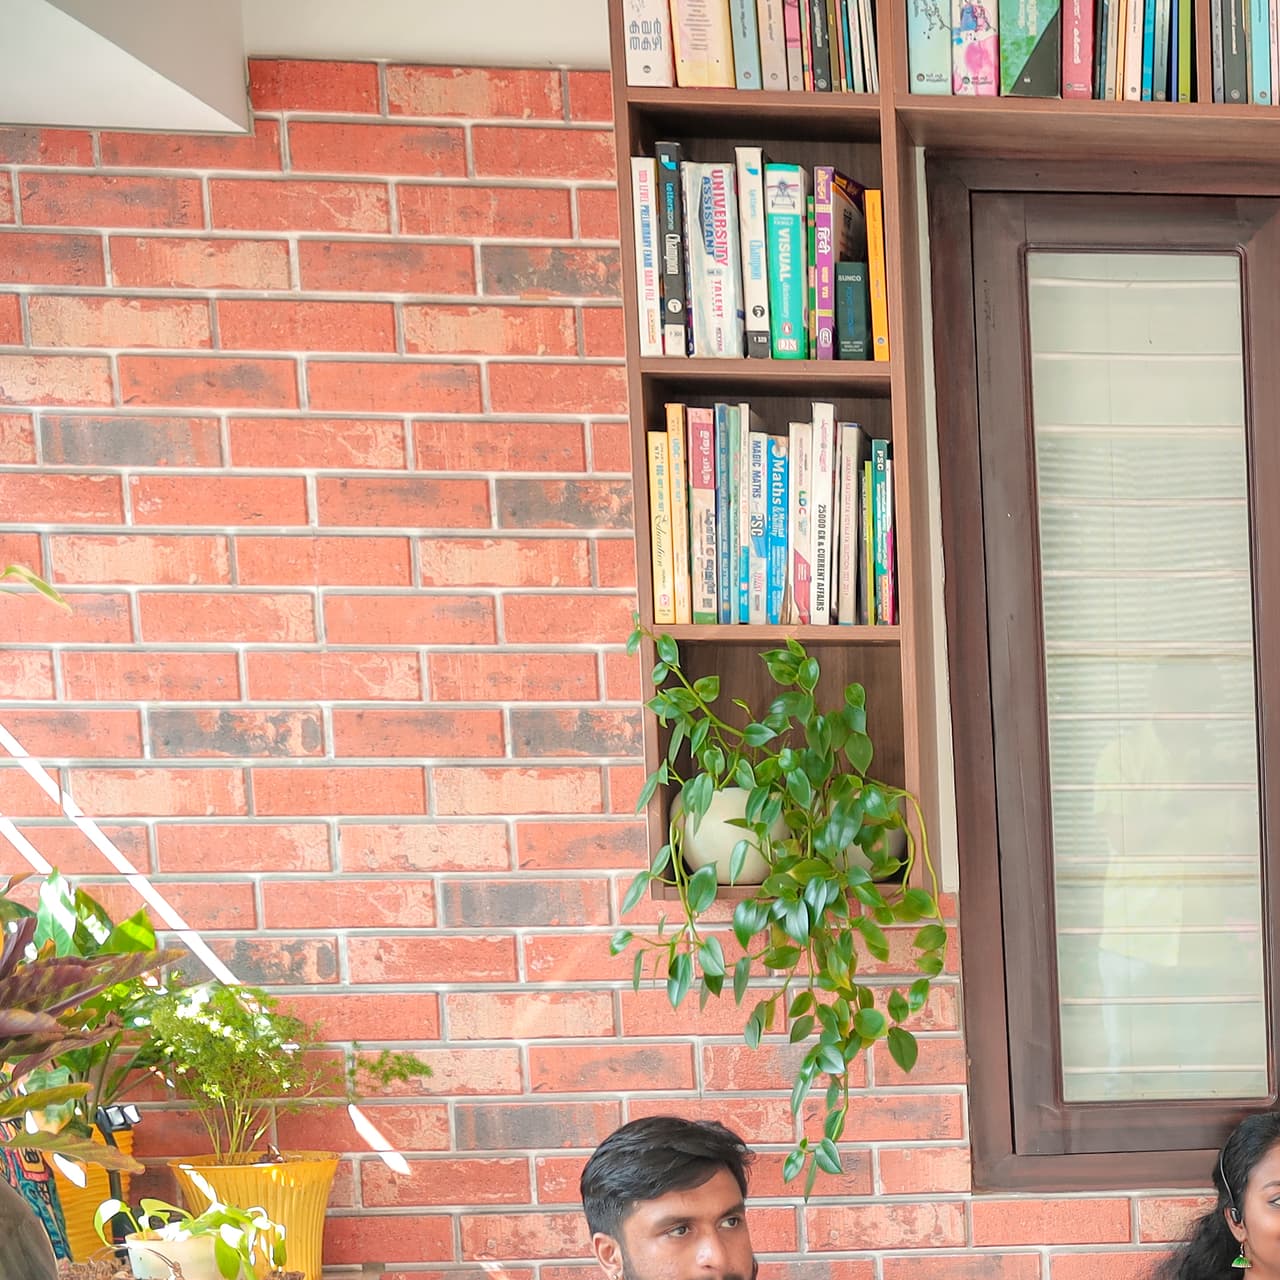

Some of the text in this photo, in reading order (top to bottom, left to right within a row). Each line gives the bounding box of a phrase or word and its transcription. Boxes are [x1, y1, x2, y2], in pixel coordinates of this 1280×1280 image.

[641, 205, 651, 248] PRELIMINARY
[703, 176, 715, 257] ASSISTANT
[711, 169, 728, 266] UNIVERSITY
[664, 233, 681, 275] Champion
[778, 228, 791, 282] VISUAL
[817, 227, 830, 254] हिंदी
[748, 240, 763, 280] Champion
[713, 280, 723, 318] TALENT
[781, 282, 791, 319] dictionary
[752, 440, 762, 467] MAGIC
[876, 450, 884, 471] PSC
[752, 470, 762, 498] MATHS
[772, 459, 785, 504] Maths
[798, 490, 807, 516] LDC
[818, 504, 826, 529] 25000
[654, 514, 668, 567] Education
[751, 513, 764, 537] PSC
[817, 548, 826, 581] CURRENT
[816, 582, 825, 611] AFFAIRS
